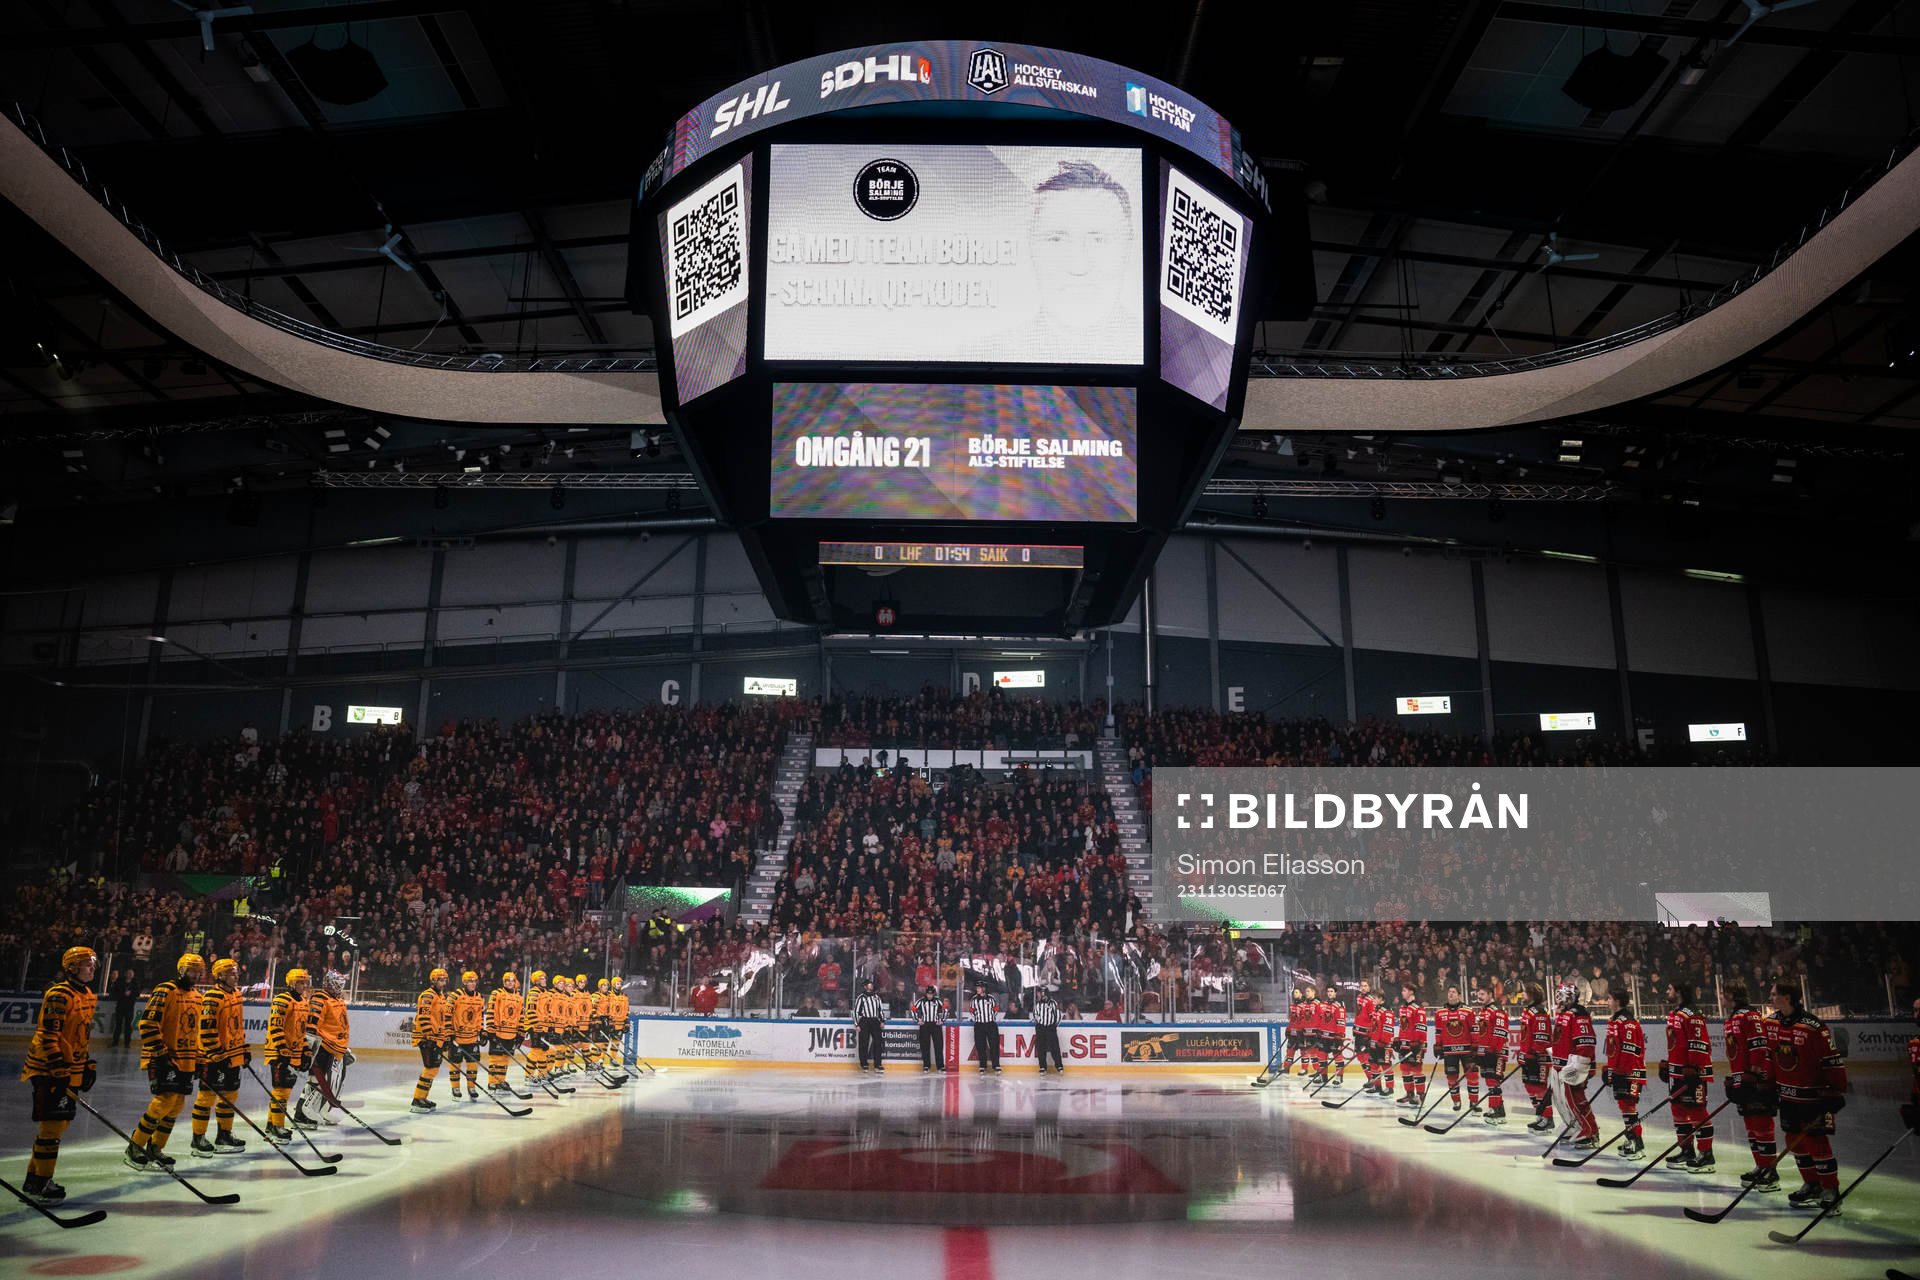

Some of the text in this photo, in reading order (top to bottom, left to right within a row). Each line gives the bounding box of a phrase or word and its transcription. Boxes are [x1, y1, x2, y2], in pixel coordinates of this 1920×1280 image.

[820, 55, 917, 98] SDHL
[1014, 63, 1062, 79] HOCKEY
[1014, 75, 1097, 98] ALLSVENSKAN
[710, 81, 790, 138] SHL
[1149, 92, 1196, 123] HOCKEY
[1152, 106, 1191, 133] ETTAN
[869, 178, 904, 190] BÖRJE
[804, 236, 853, 264] MED
[868, 237, 934, 264] TEAM
[795, 431, 930, 468] OMGÅNG 21
[968, 433, 1123, 457] BÖRJE SALMING
[968, 456, 1065, 469] ALS-STIFTELSE
[874, 546, 1030, 562] 0 LHF 01:54 SAIK 0
[661, 679, 679, 706] C
[1228, 687, 1246, 713] E
[312, 705, 332, 731] B
[1538, 1022, 1546, 1031] 19
[1580, 1025, 1588, 1034] 31
[1695, 1027, 1701, 1037] 3
[1755, 1023, 1762, 1033] 5
[809, 1027, 857, 1052] JWAB
[881, 1031, 917, 1040] Utbildning
[1186, 1036, 1243, 1047] LULEÅ HOCKEY
[1626, 1030, 1632, 1040] 6
[692, 1040, 736, 1048] PATOMELLA
[1175, 1048, 1253, 1057] RESTAURANGERNA
